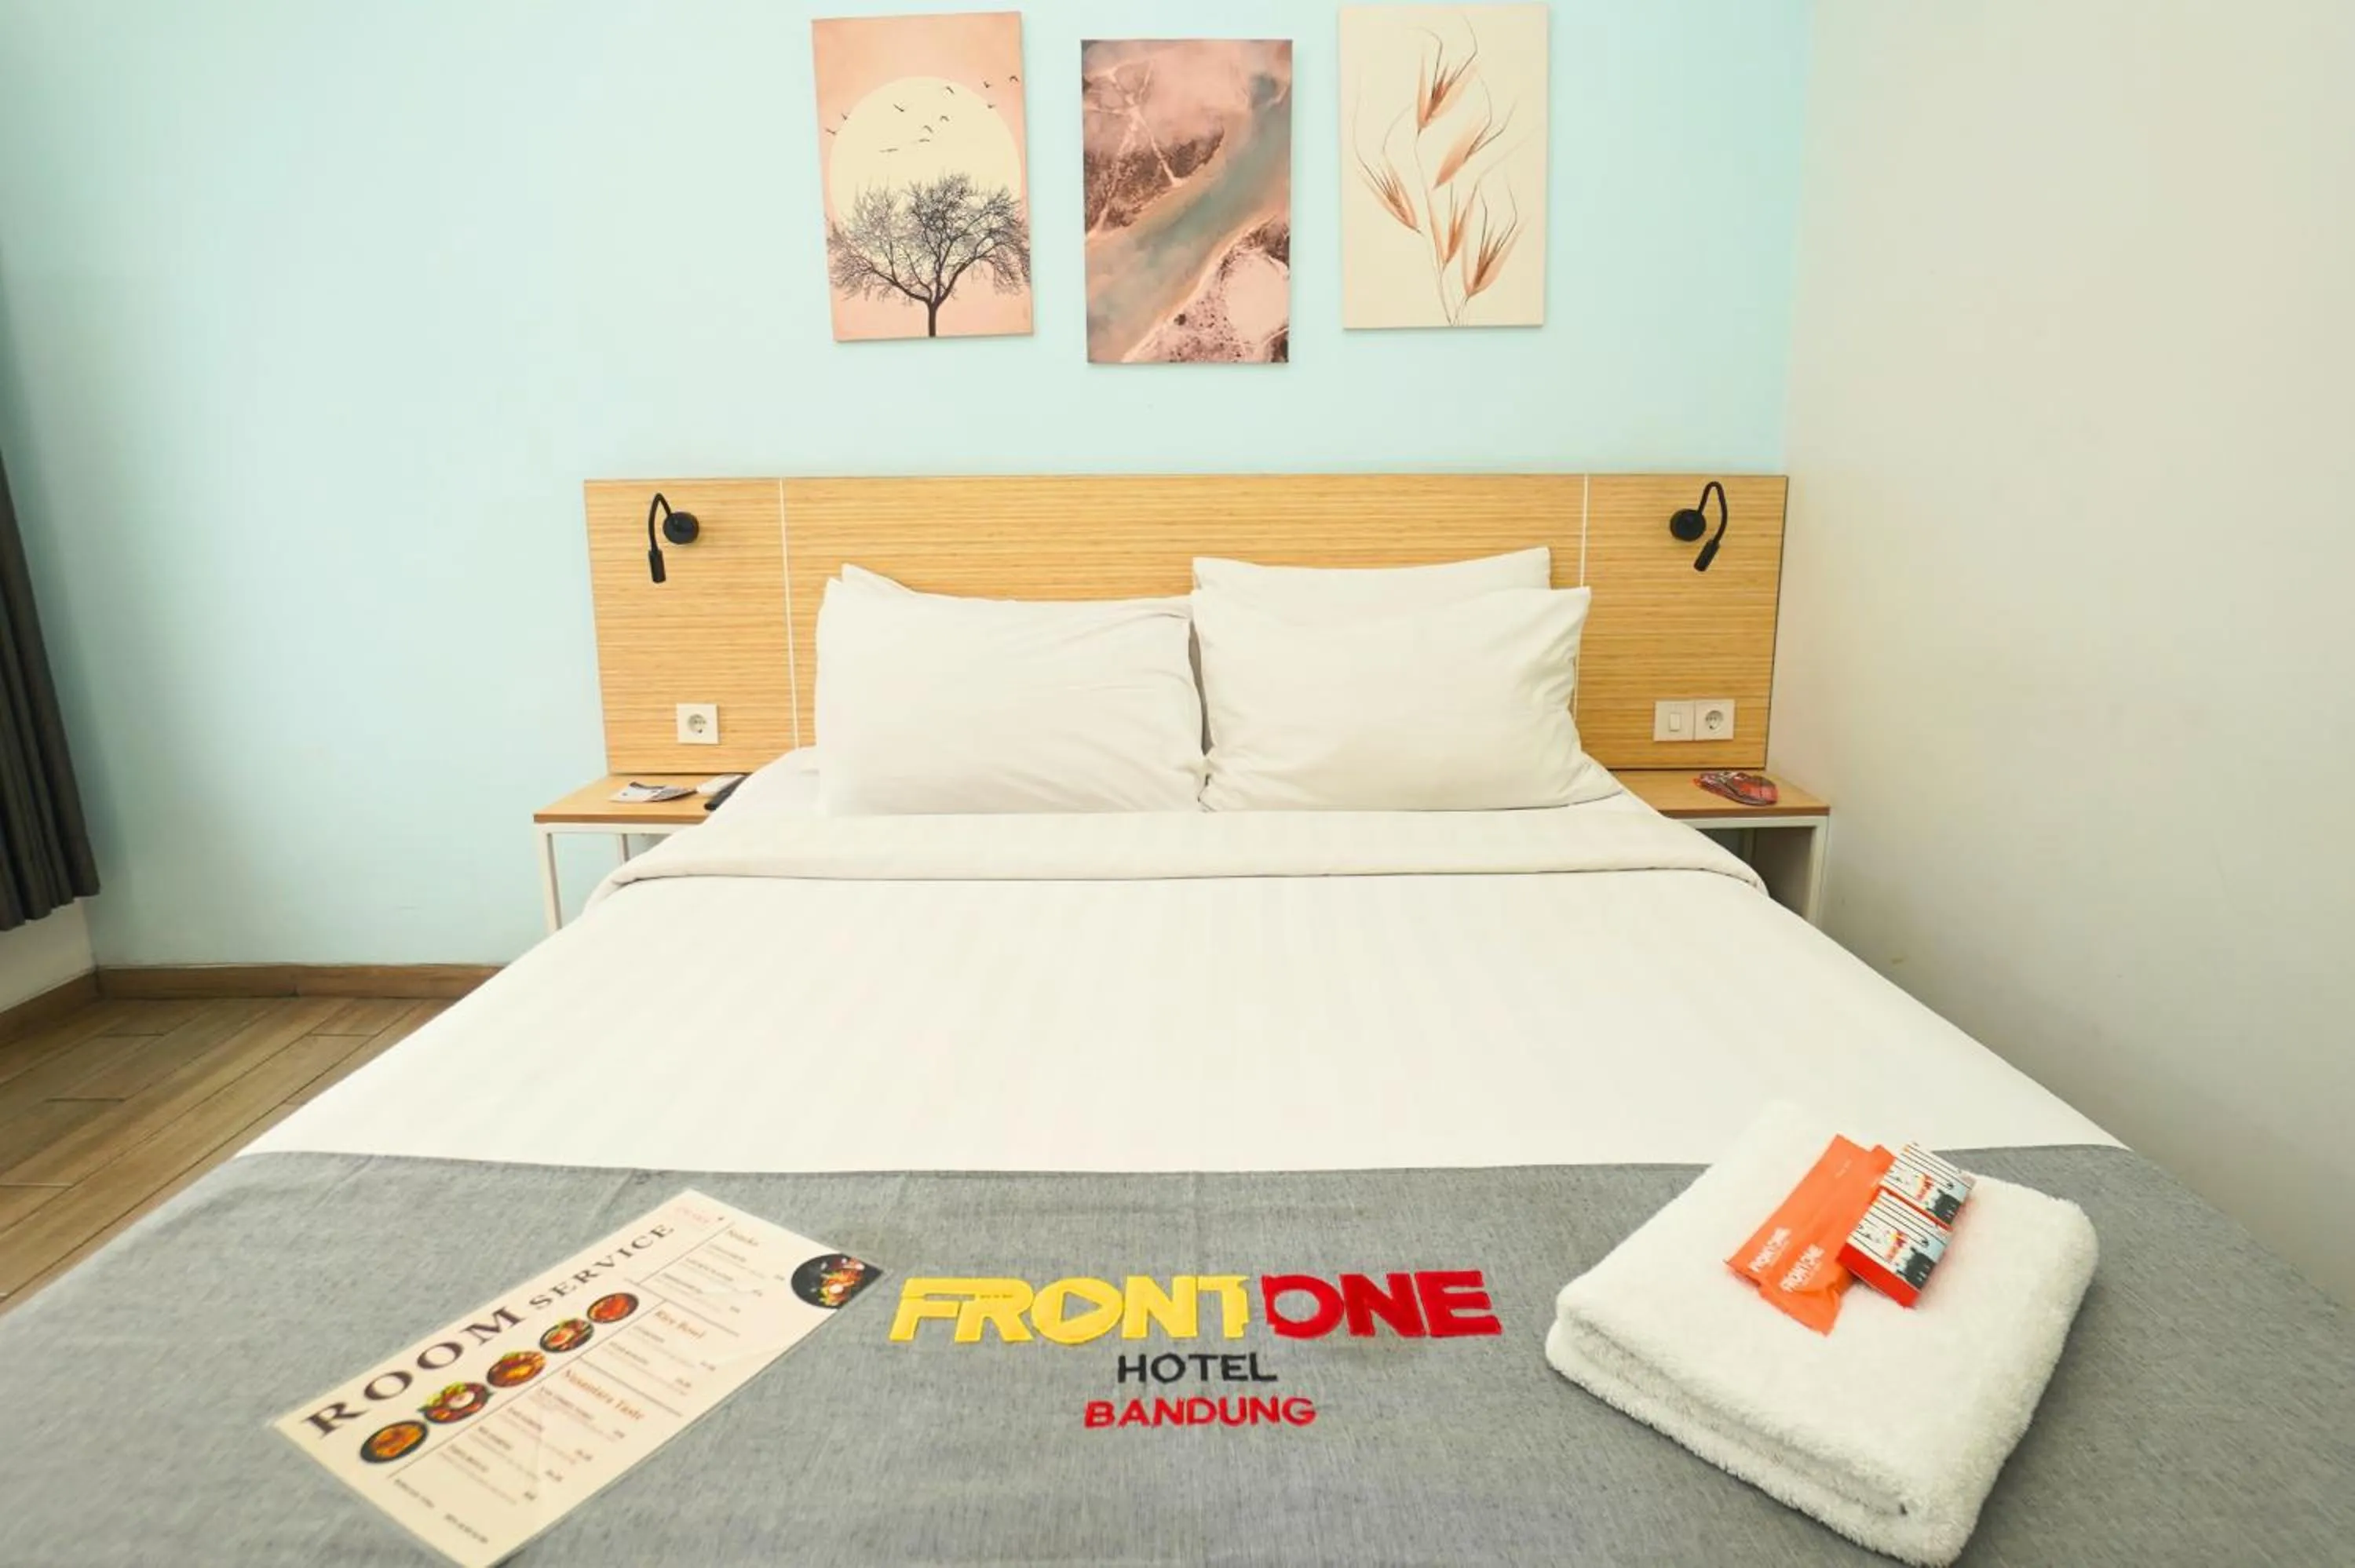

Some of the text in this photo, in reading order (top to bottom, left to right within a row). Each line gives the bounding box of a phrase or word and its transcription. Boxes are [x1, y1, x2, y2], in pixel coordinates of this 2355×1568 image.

[301, 1223, 675, 1439] ROOM SERVICE
[1117, 1352, 1278, 1384] HOTEL
[1083, 1396, 1317, 1428] BANDUNG
